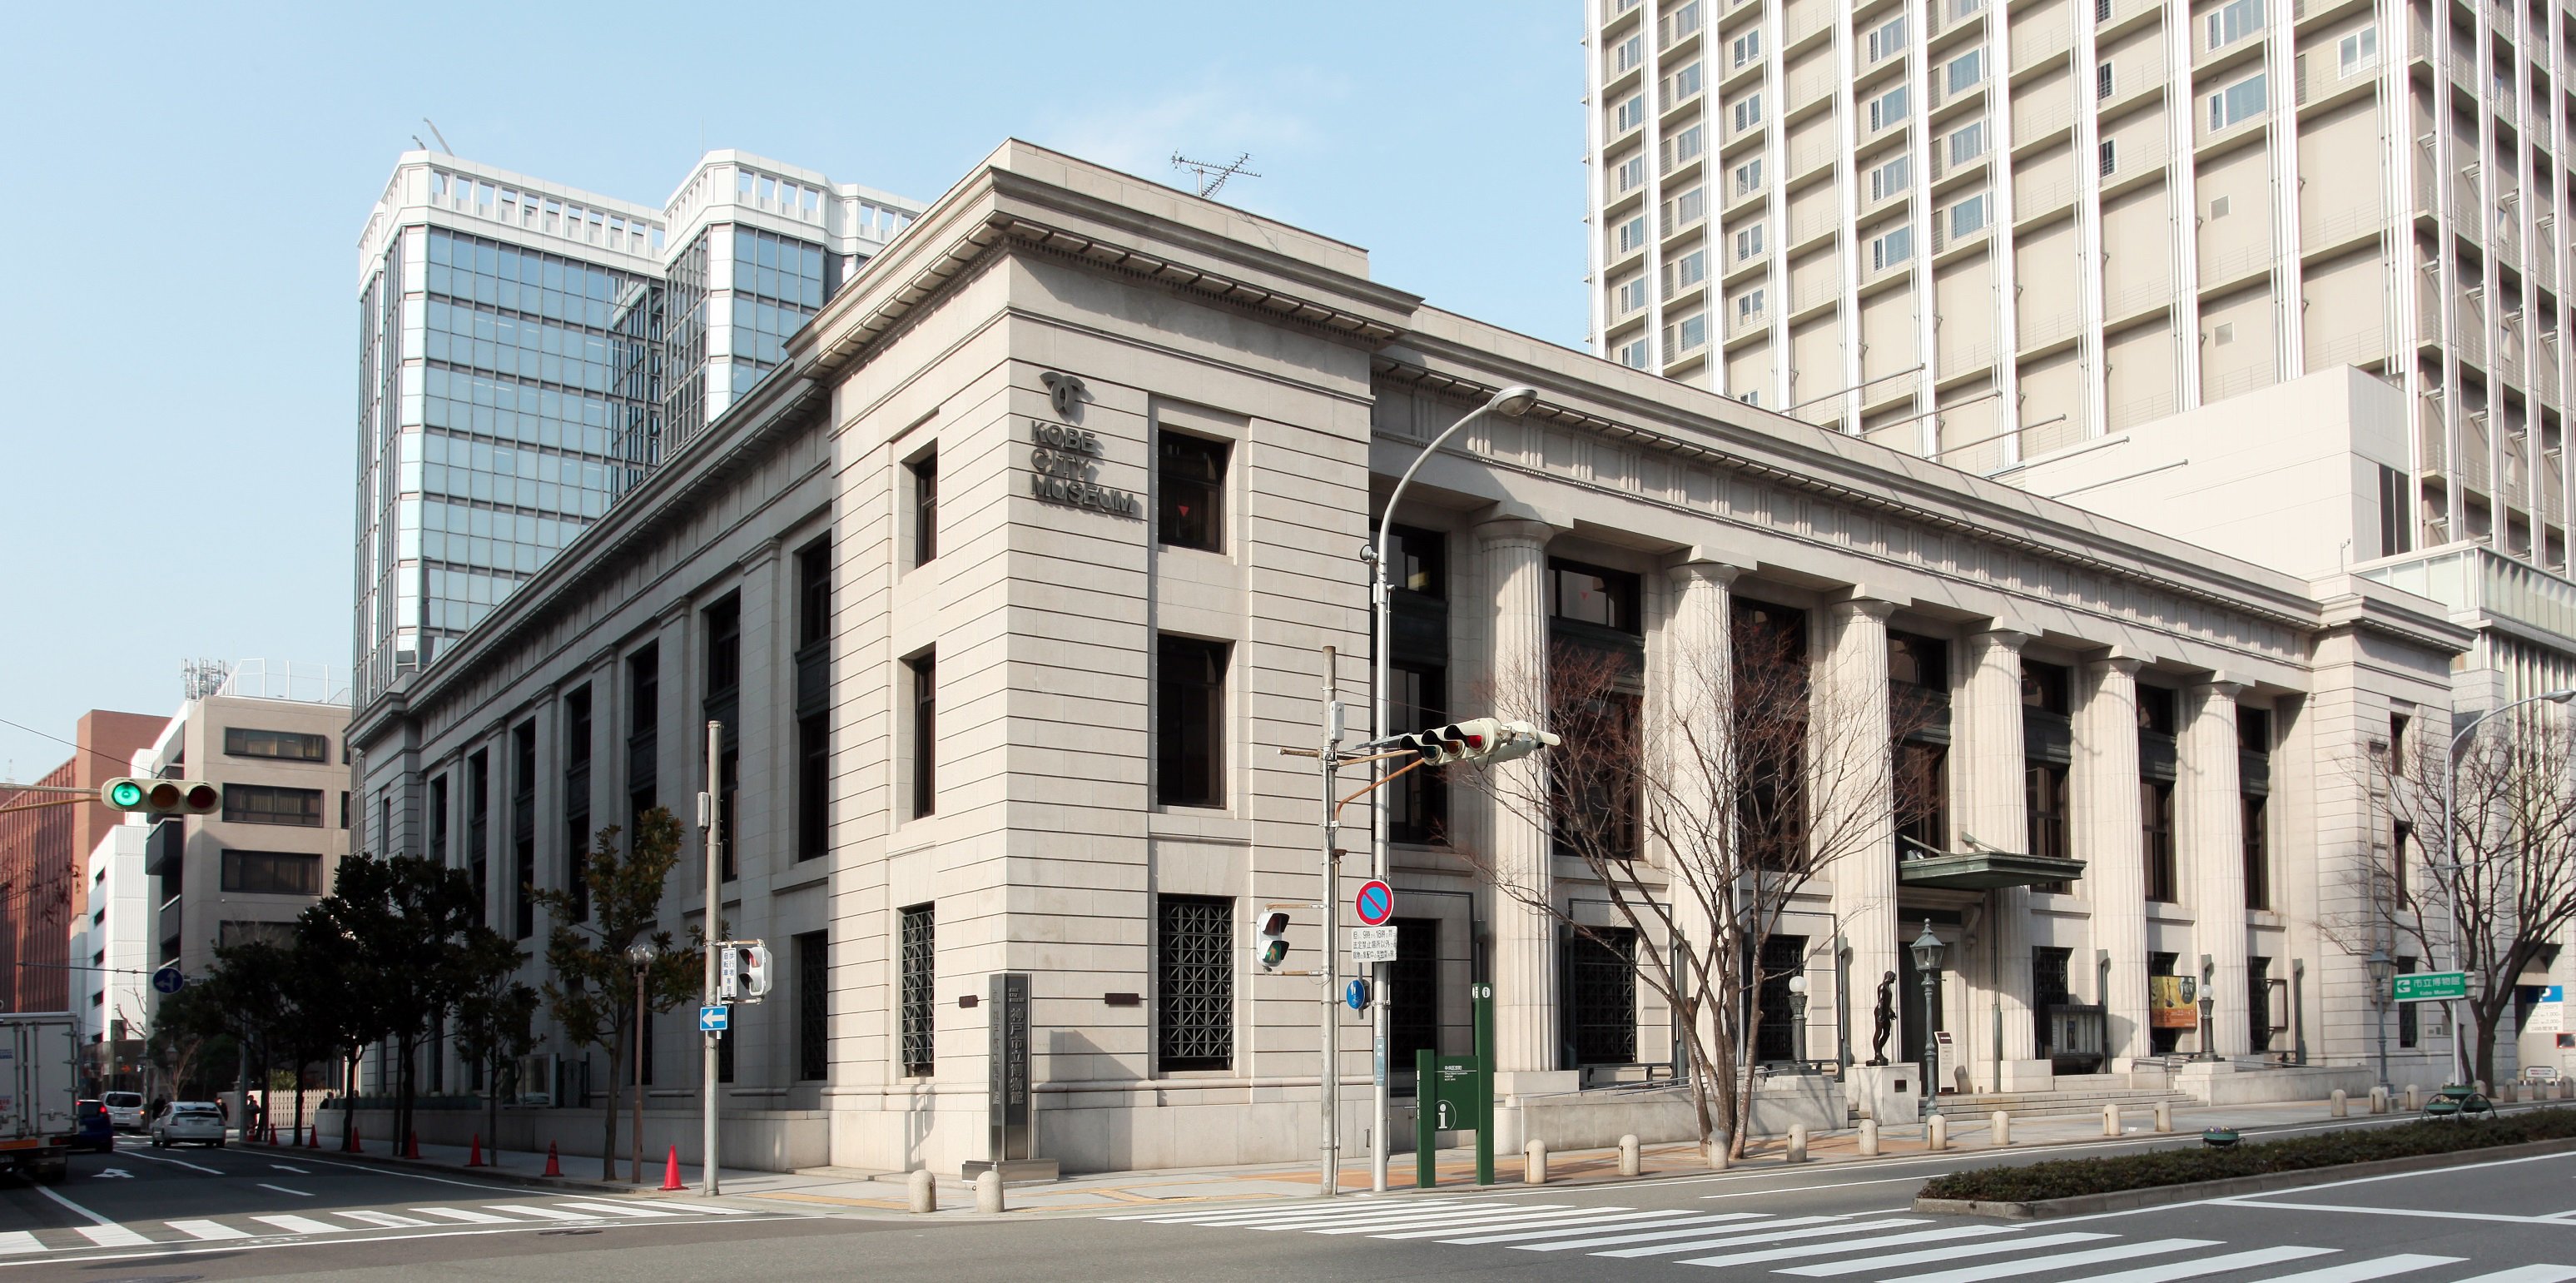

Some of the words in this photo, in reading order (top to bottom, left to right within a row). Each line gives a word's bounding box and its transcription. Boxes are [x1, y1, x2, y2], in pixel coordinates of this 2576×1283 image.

[1030, 420, 1096, 454] KOBE
[1030, 447, 1091, 479] CITY
[1030, 473, 1134, 514] MUSEUM
[2413, 976, 2460, 988] 市立博物館
[1010, 1007, 1025, 1106] 神戸市立博物館
